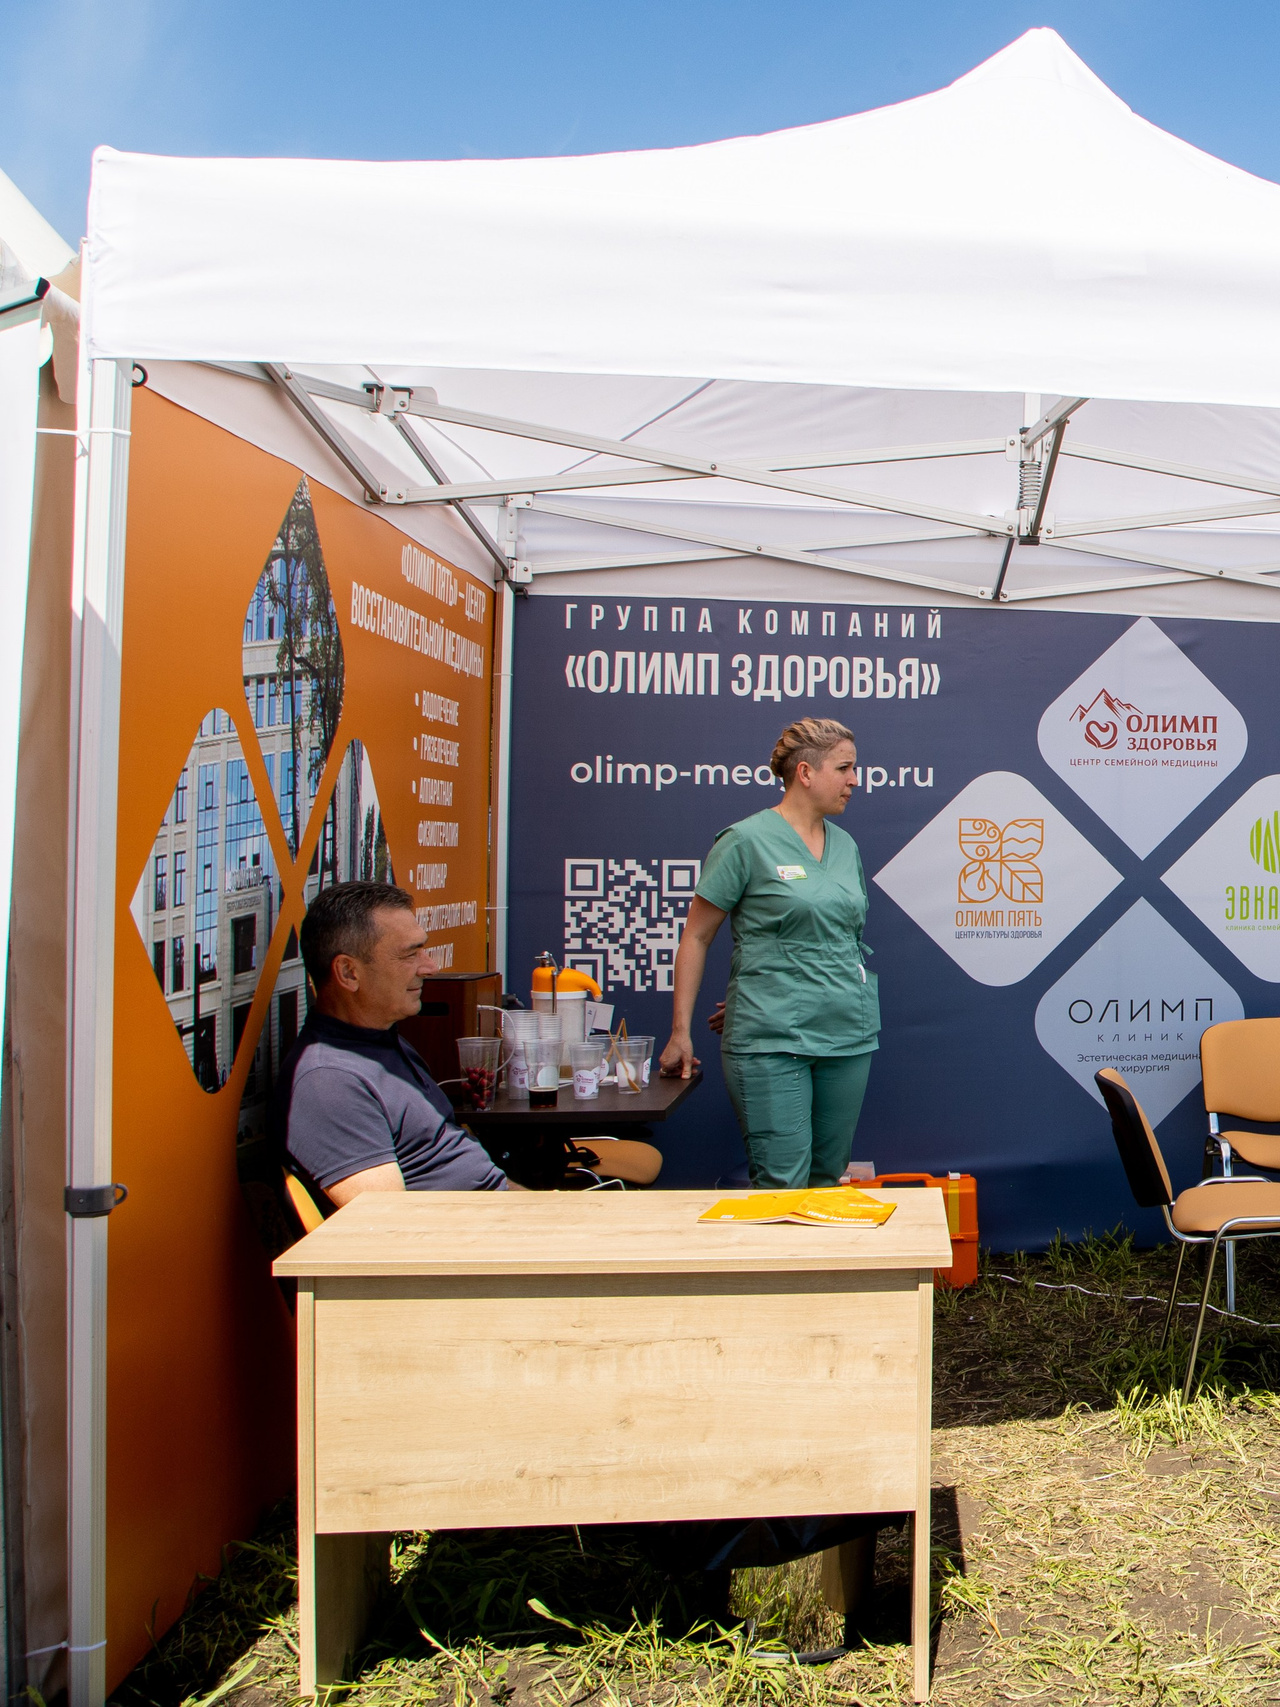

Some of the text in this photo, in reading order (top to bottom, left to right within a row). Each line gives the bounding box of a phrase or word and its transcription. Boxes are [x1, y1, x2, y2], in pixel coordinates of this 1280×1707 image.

[401, 543, 486, 624] «ОЛИМП ПЯТЬ» ЦЕНТР
[350, 580, 484, 679] ВОССТАНОВИТЕЛЬНОЙ МЕДИЦИНЫ
[565, 603, 942, 639] ГРУППА КОМПАНИЙ
[564, 650, 941, 702] «ОЛИМП ЗДОРОВЬЯ»
[422, 690, 459, 726] ВОДОЛЕЧЕНИЕ
[1126, 713, 1219, 734] ОЛИМП
[420, 734, 459, 767] ГРЯЗЕЛЕЧЕНИЕ
[1126, 736, 1218, 753] ЗДОРОВЬЯ
[1069, 756, 1218, 768] ЦЕНТР СЕМЕЙНОЙ МЕДИЦИНЫ
[419, 777, 453, 806] АППАРАТНАЯ
[417, 820, 458, 847] ФИЗИОТЕРАПИЯ
[416, 863, 447, 892] СТАЦИОНАР
[954, 909, 1043, 928] ОЛИМП ПЯТЬ
[1225, 924, 1255, 932] клиника
[954, 930, 1043, 940] ЦЕНТР КУЛЬТУРЫ ЗДОРОВЬЯ
[1068, 998, 1213, 1024] ОЛИМП
[1097, 1032, 1184, 1043] КЛИНИК
[1077, 1053, 1148, 1063] Эстетическая
[1120, 1064, 1170, 1074] хирургия
[807, 1211, 874, 1222] ПРИГЛАШЕНИЕ
